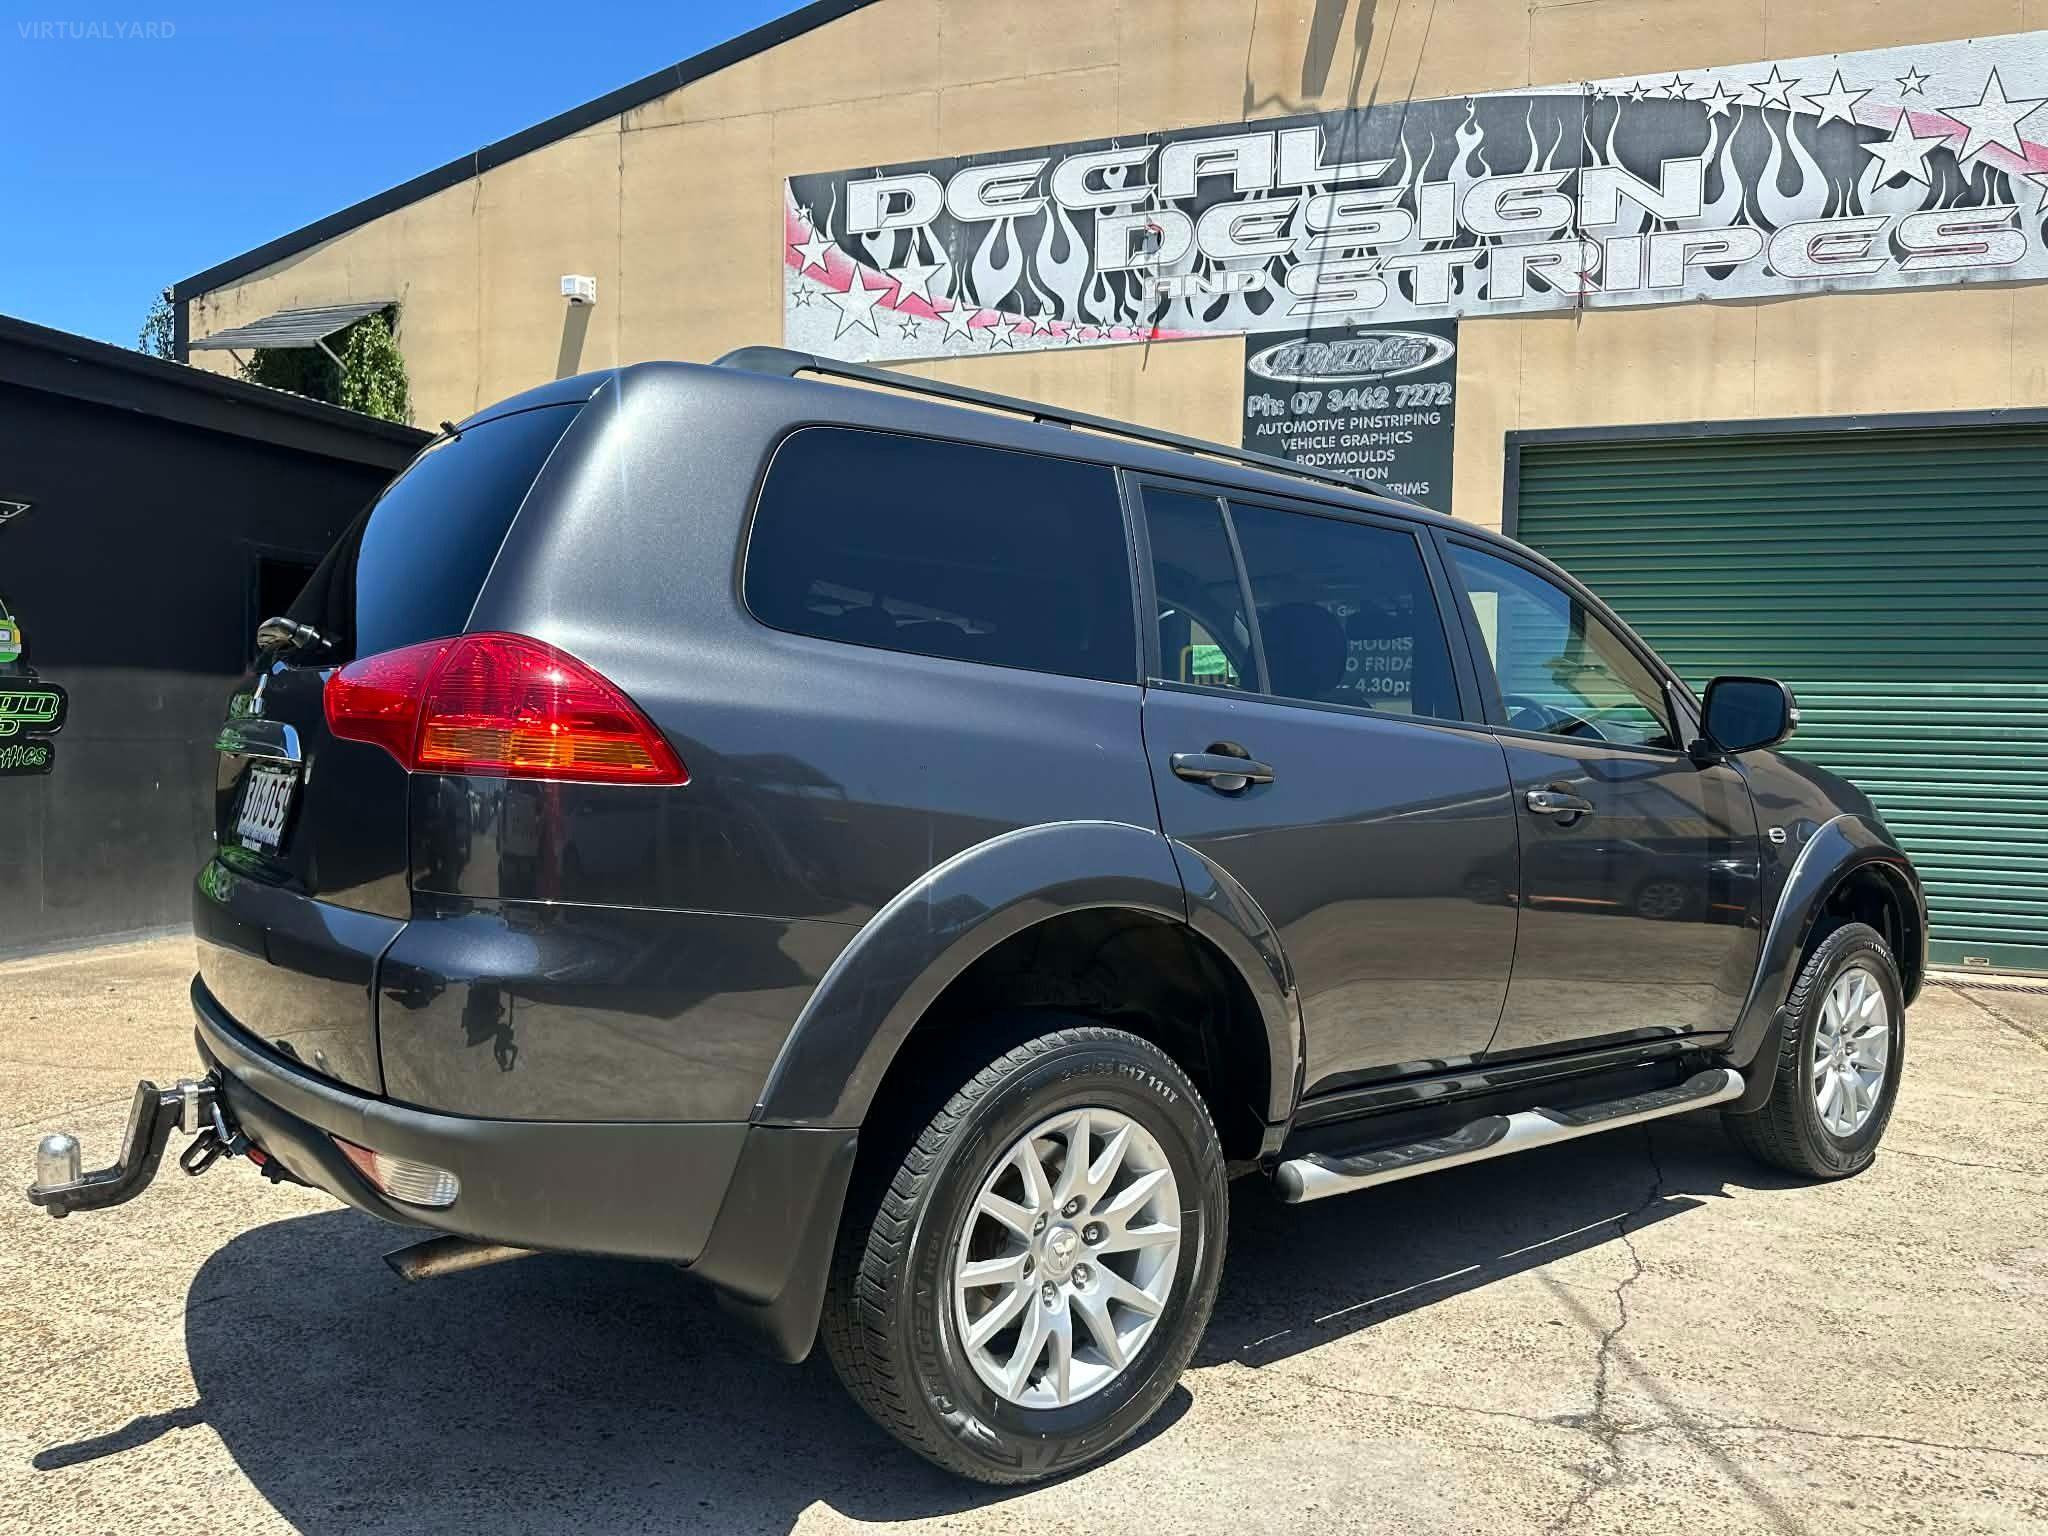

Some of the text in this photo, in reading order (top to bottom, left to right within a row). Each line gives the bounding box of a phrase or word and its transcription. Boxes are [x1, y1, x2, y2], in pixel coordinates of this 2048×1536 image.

[846, 125, 1397, 234] DECAL
[1094, 157, 1704, 271] DESIGN
[1143, 204, 2029, 318] AND STRIPES
[1290, 391, 1323, 415] 07
[1327, 386, 1390, 412] 3462
[1395, 382, 1453, 409] 7272
[1256, 412, 1441, 436] AUTOMOTIVE PINSTRIPING
[1281, 431, 1413, 451] VEHICLE GRAPHICS
[1296, 449, 1395, 466] BODYMOULDS
